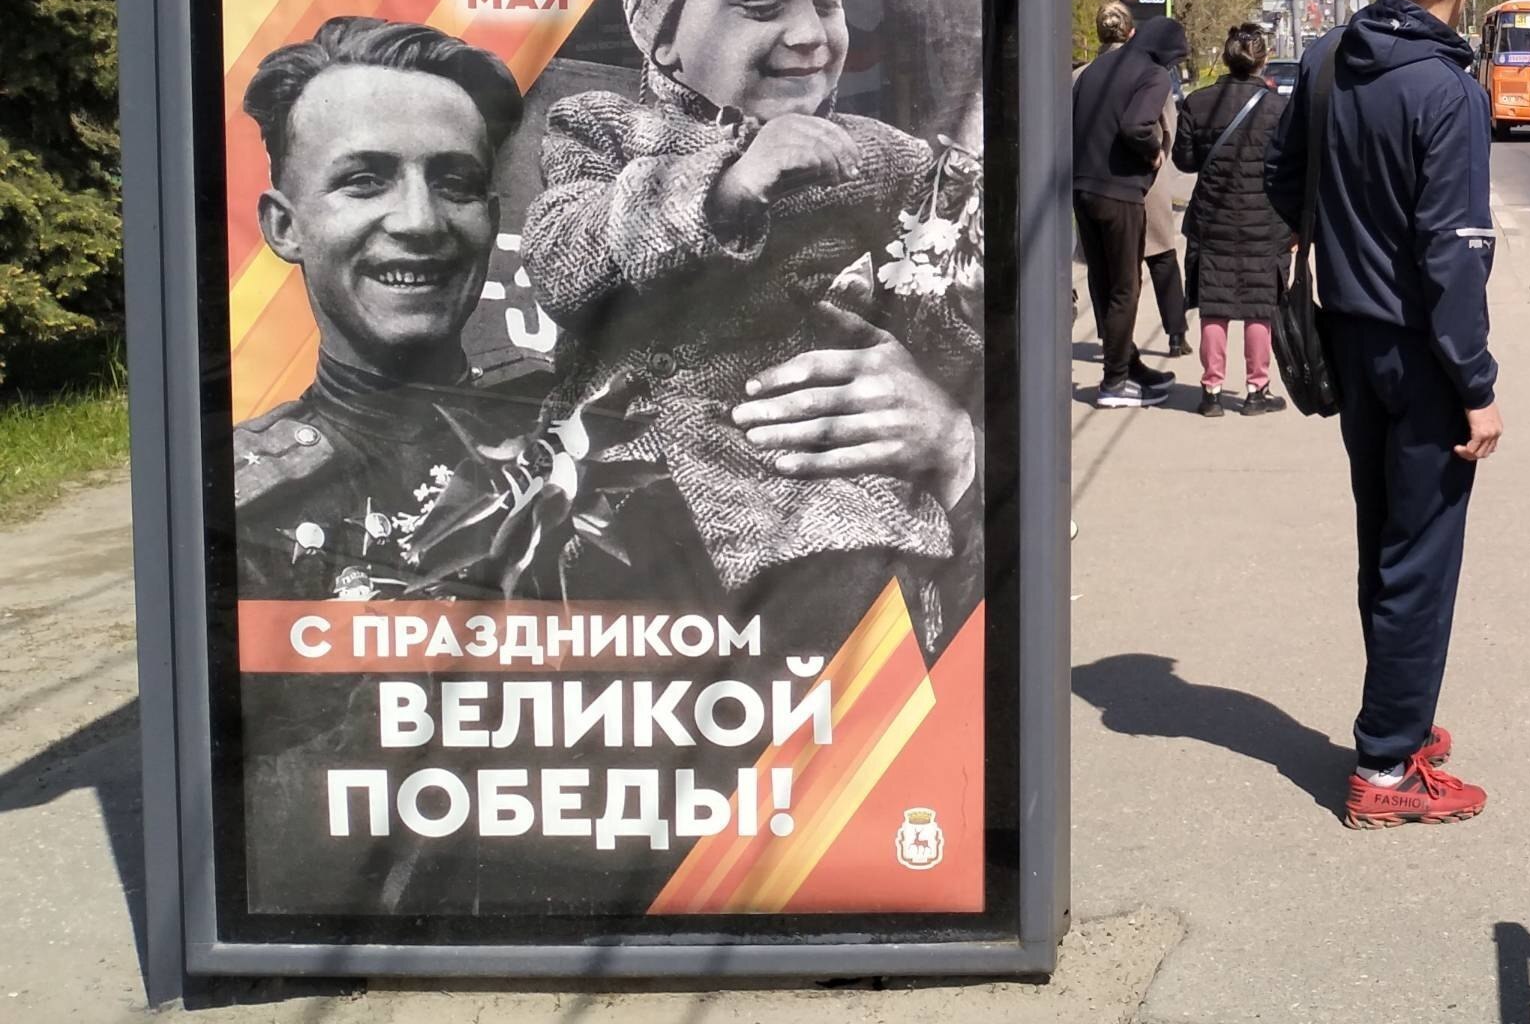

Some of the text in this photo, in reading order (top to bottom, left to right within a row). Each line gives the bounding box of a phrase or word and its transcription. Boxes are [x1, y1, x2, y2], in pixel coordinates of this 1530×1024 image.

[290, 614, 762, 666] С ПРАЗДНИКОМ
[379, 656, 833, 747] ВЕЛИКОЙ
[328, 767, 796, 850] ПОБЕДЫ!
[1374, 793, 1428, 809] FASHIO
